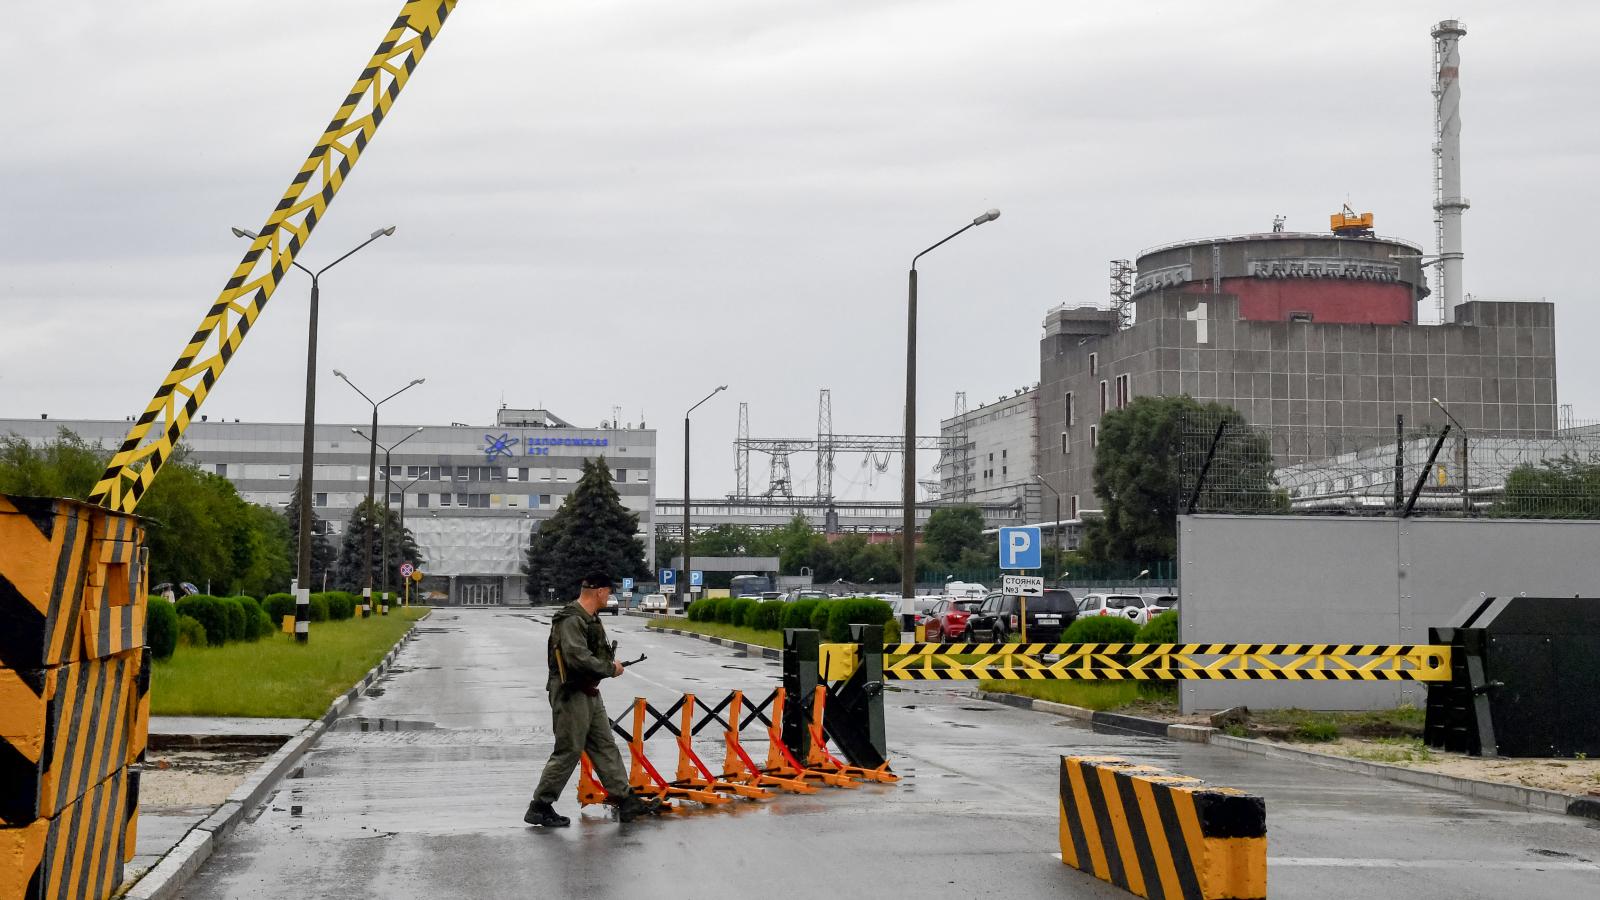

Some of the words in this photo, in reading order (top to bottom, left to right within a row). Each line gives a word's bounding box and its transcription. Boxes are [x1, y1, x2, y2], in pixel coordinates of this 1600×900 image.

[1187, 303, 1208, 343] 1
[1009, 531, 1031, 564] P
[664, 571, 673, 583] P
[692, 573, 699, 583] P
[1005, 577, 1041, 586] СТОЯНКА
